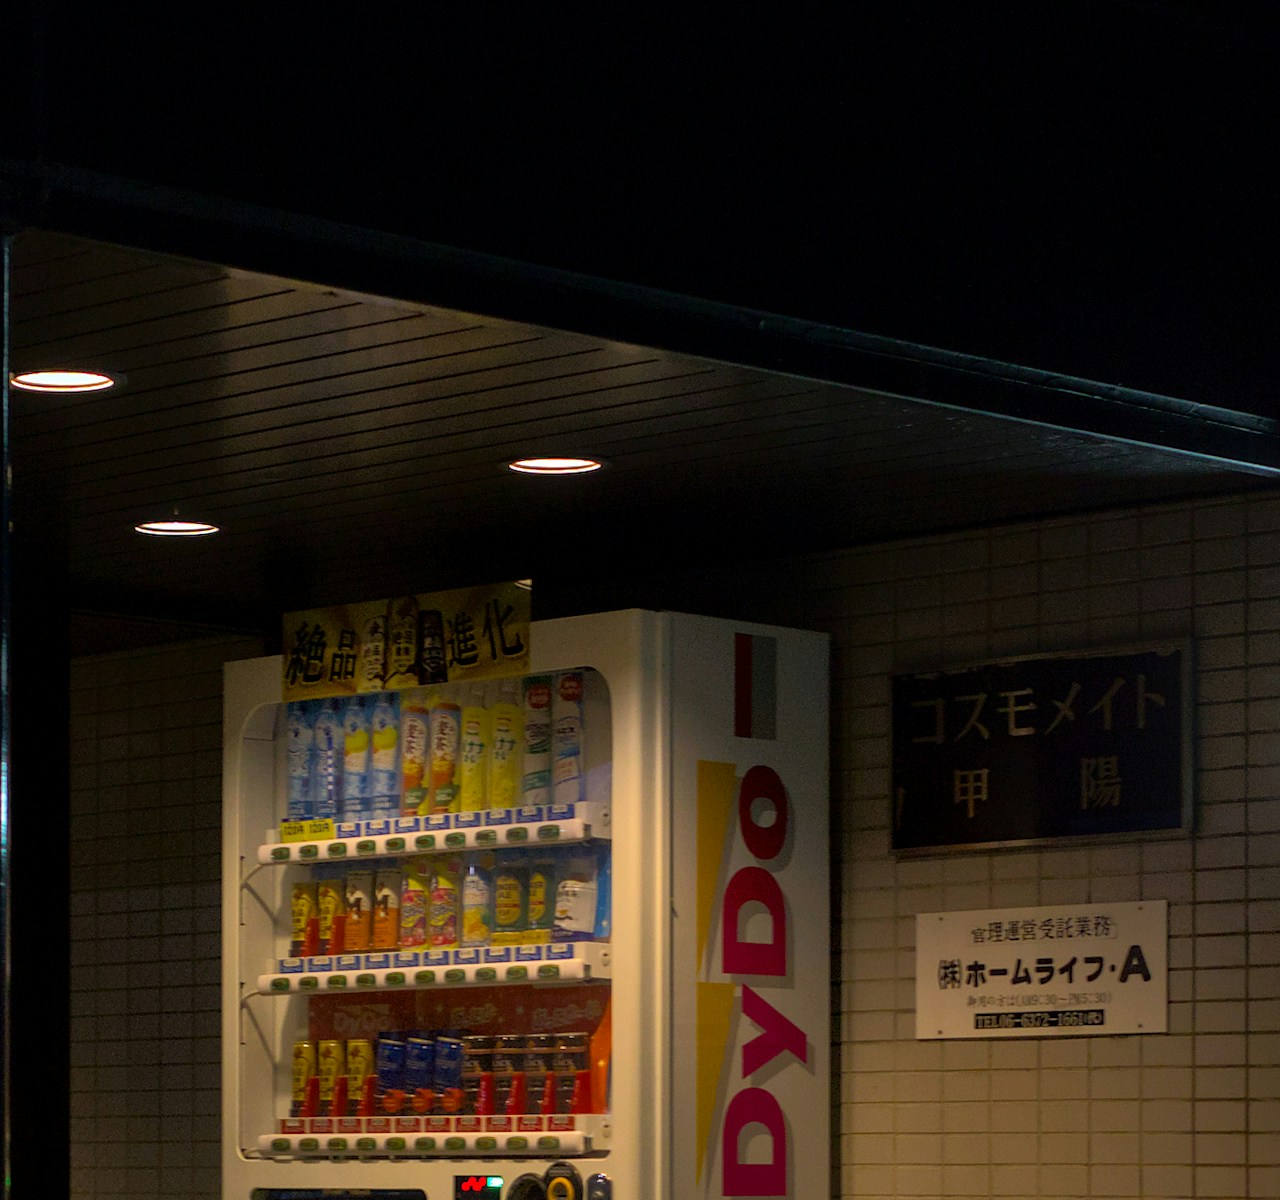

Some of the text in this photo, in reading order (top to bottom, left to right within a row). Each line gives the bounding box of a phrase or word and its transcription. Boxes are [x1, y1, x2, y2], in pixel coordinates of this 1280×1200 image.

[286, 619, 359, 686] 絶品
[446, 597, 525, 668] 進化
[910, 673, 1166, 744] コスモメイト
